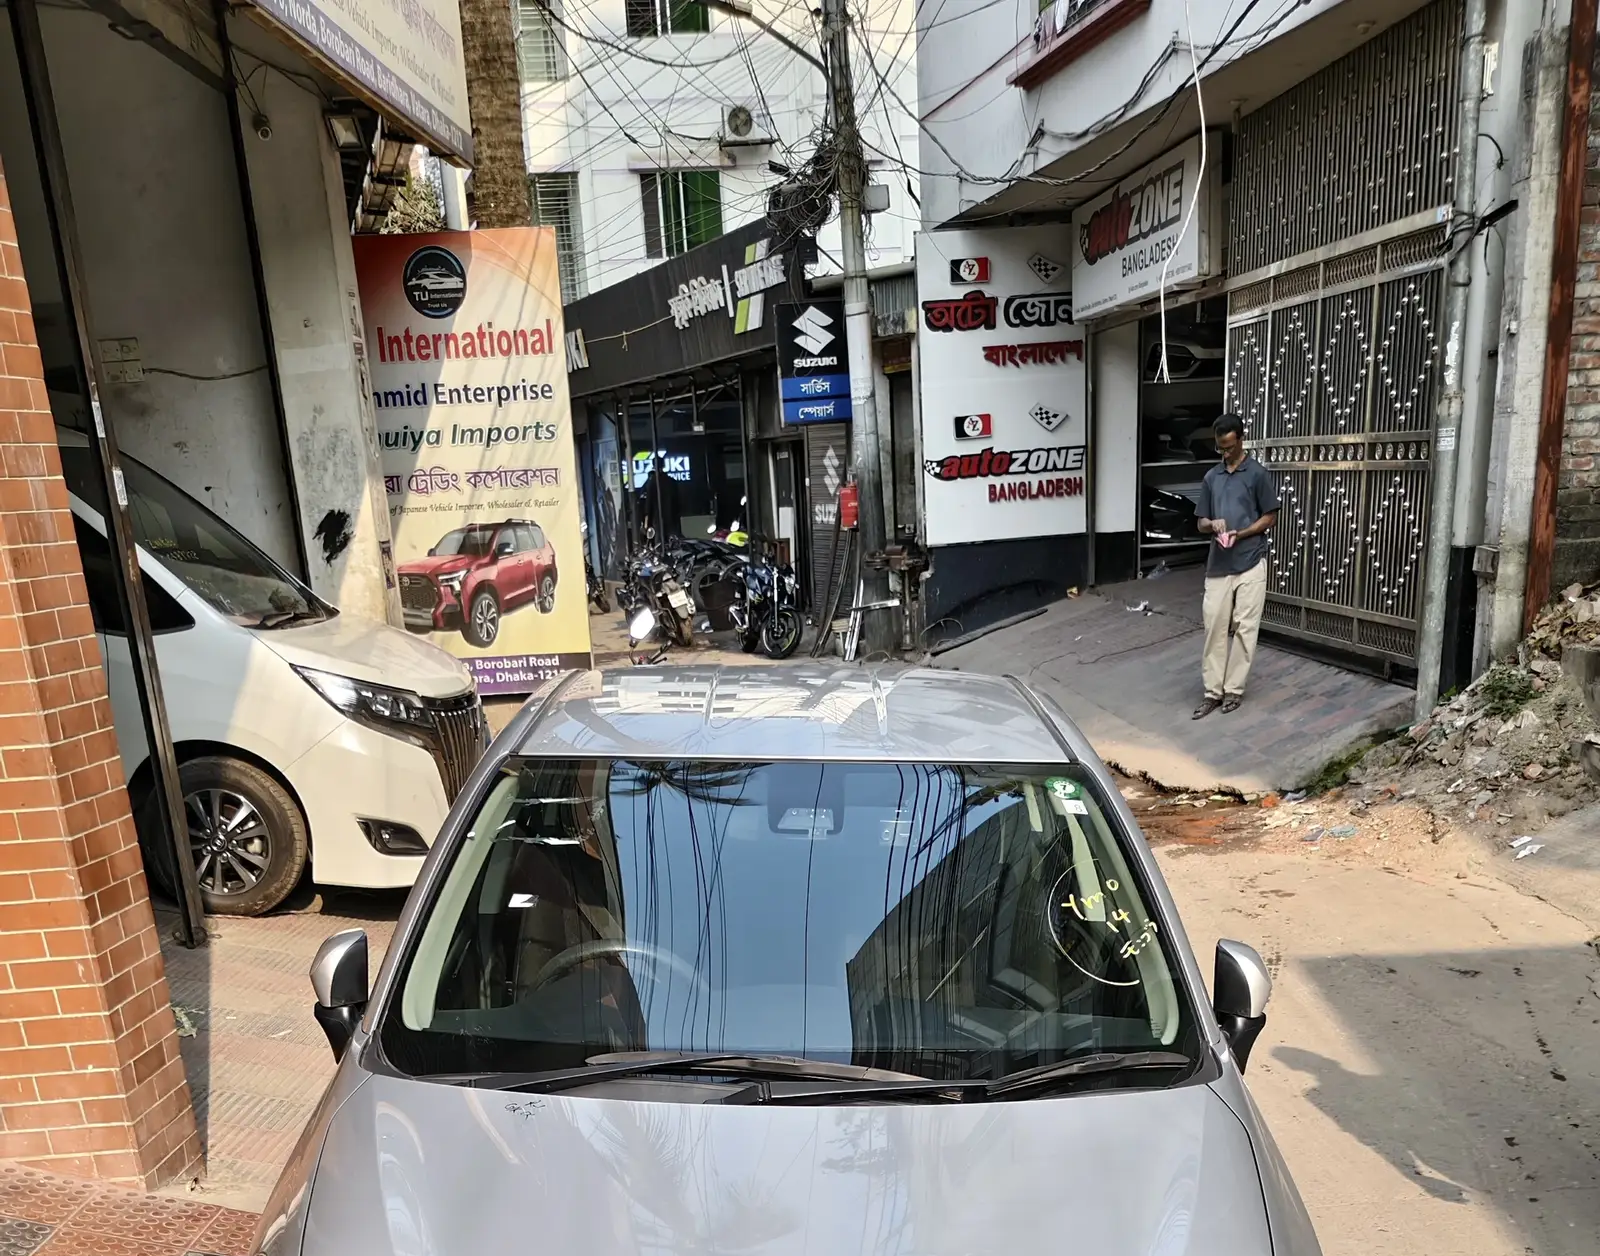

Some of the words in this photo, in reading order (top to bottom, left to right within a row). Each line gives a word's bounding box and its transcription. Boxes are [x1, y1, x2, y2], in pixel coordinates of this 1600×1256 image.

[320, 16, 356, 68] Borobari
[1121, 233, 1180, 278] BANGLADESH
[413, 291, 429, 301] TU
[922, 290, 998, 332] অটো
[377, 319, 555, 362] International
[982, 340, 1084, 369] বাংলাদেশ
[793, 356, 838, 368] SUZUKI
[434, 379, 553, 408] Enterprise
[800, 378, 830, 395] সার্ভিস
[379, 425, 442, 451] uiya
[451, 421, 556, 448] Imports
[408, 466, 461, 495] ট্রেডিং
[466, 465, 559, 489] কর্পোরেশন
[988, 477, 1083, 503] BANGLADESH
[390, 505, 398, 515] of
[398, 504, 428, 515] Japanese
[430, 503, 453, 512] Vehicle
[487, 500, 523, 509] Wholesaler
[534, 498, 560, 508] Retailer
[475, 657, 527, 670] Borobari
[530, 655, 560, 667] Road
[496, 669, 565, 683] Dhaka-121
